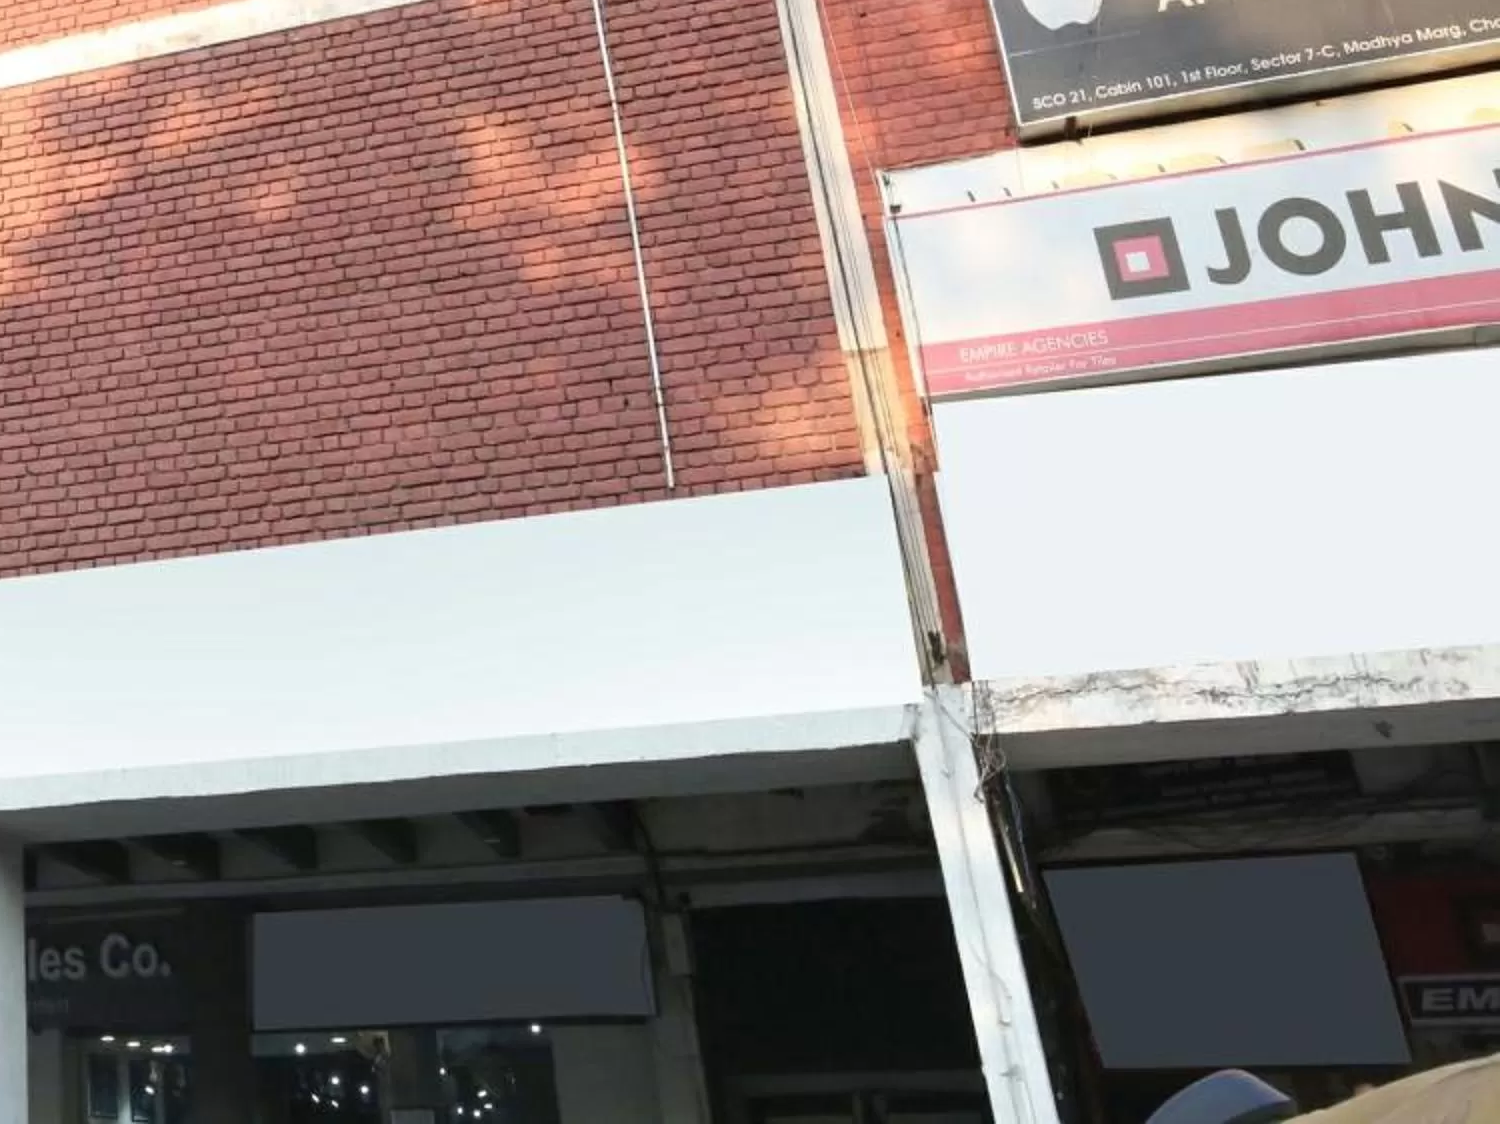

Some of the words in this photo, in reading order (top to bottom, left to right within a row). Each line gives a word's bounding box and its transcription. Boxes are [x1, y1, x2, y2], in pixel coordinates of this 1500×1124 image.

[1032, 94, 1066, 110] SCO
[1095, 80, 1142, 99] Cabin
[1147, 73, 1177, 89] 101,
[1183, 69, 1202, 84] 1st
[1204, 62, 1249, 79] Floor,
[1251, 49, 1301, 71] Sector
[1416, 23, 1467, 42] Marg,
[959, 342, 1017, 364] EMPIRE
[1021, 329, 1109, 354] AGENCIES
[28, 937, 86, 981] les
[100, 932, 172, 978] Co.
